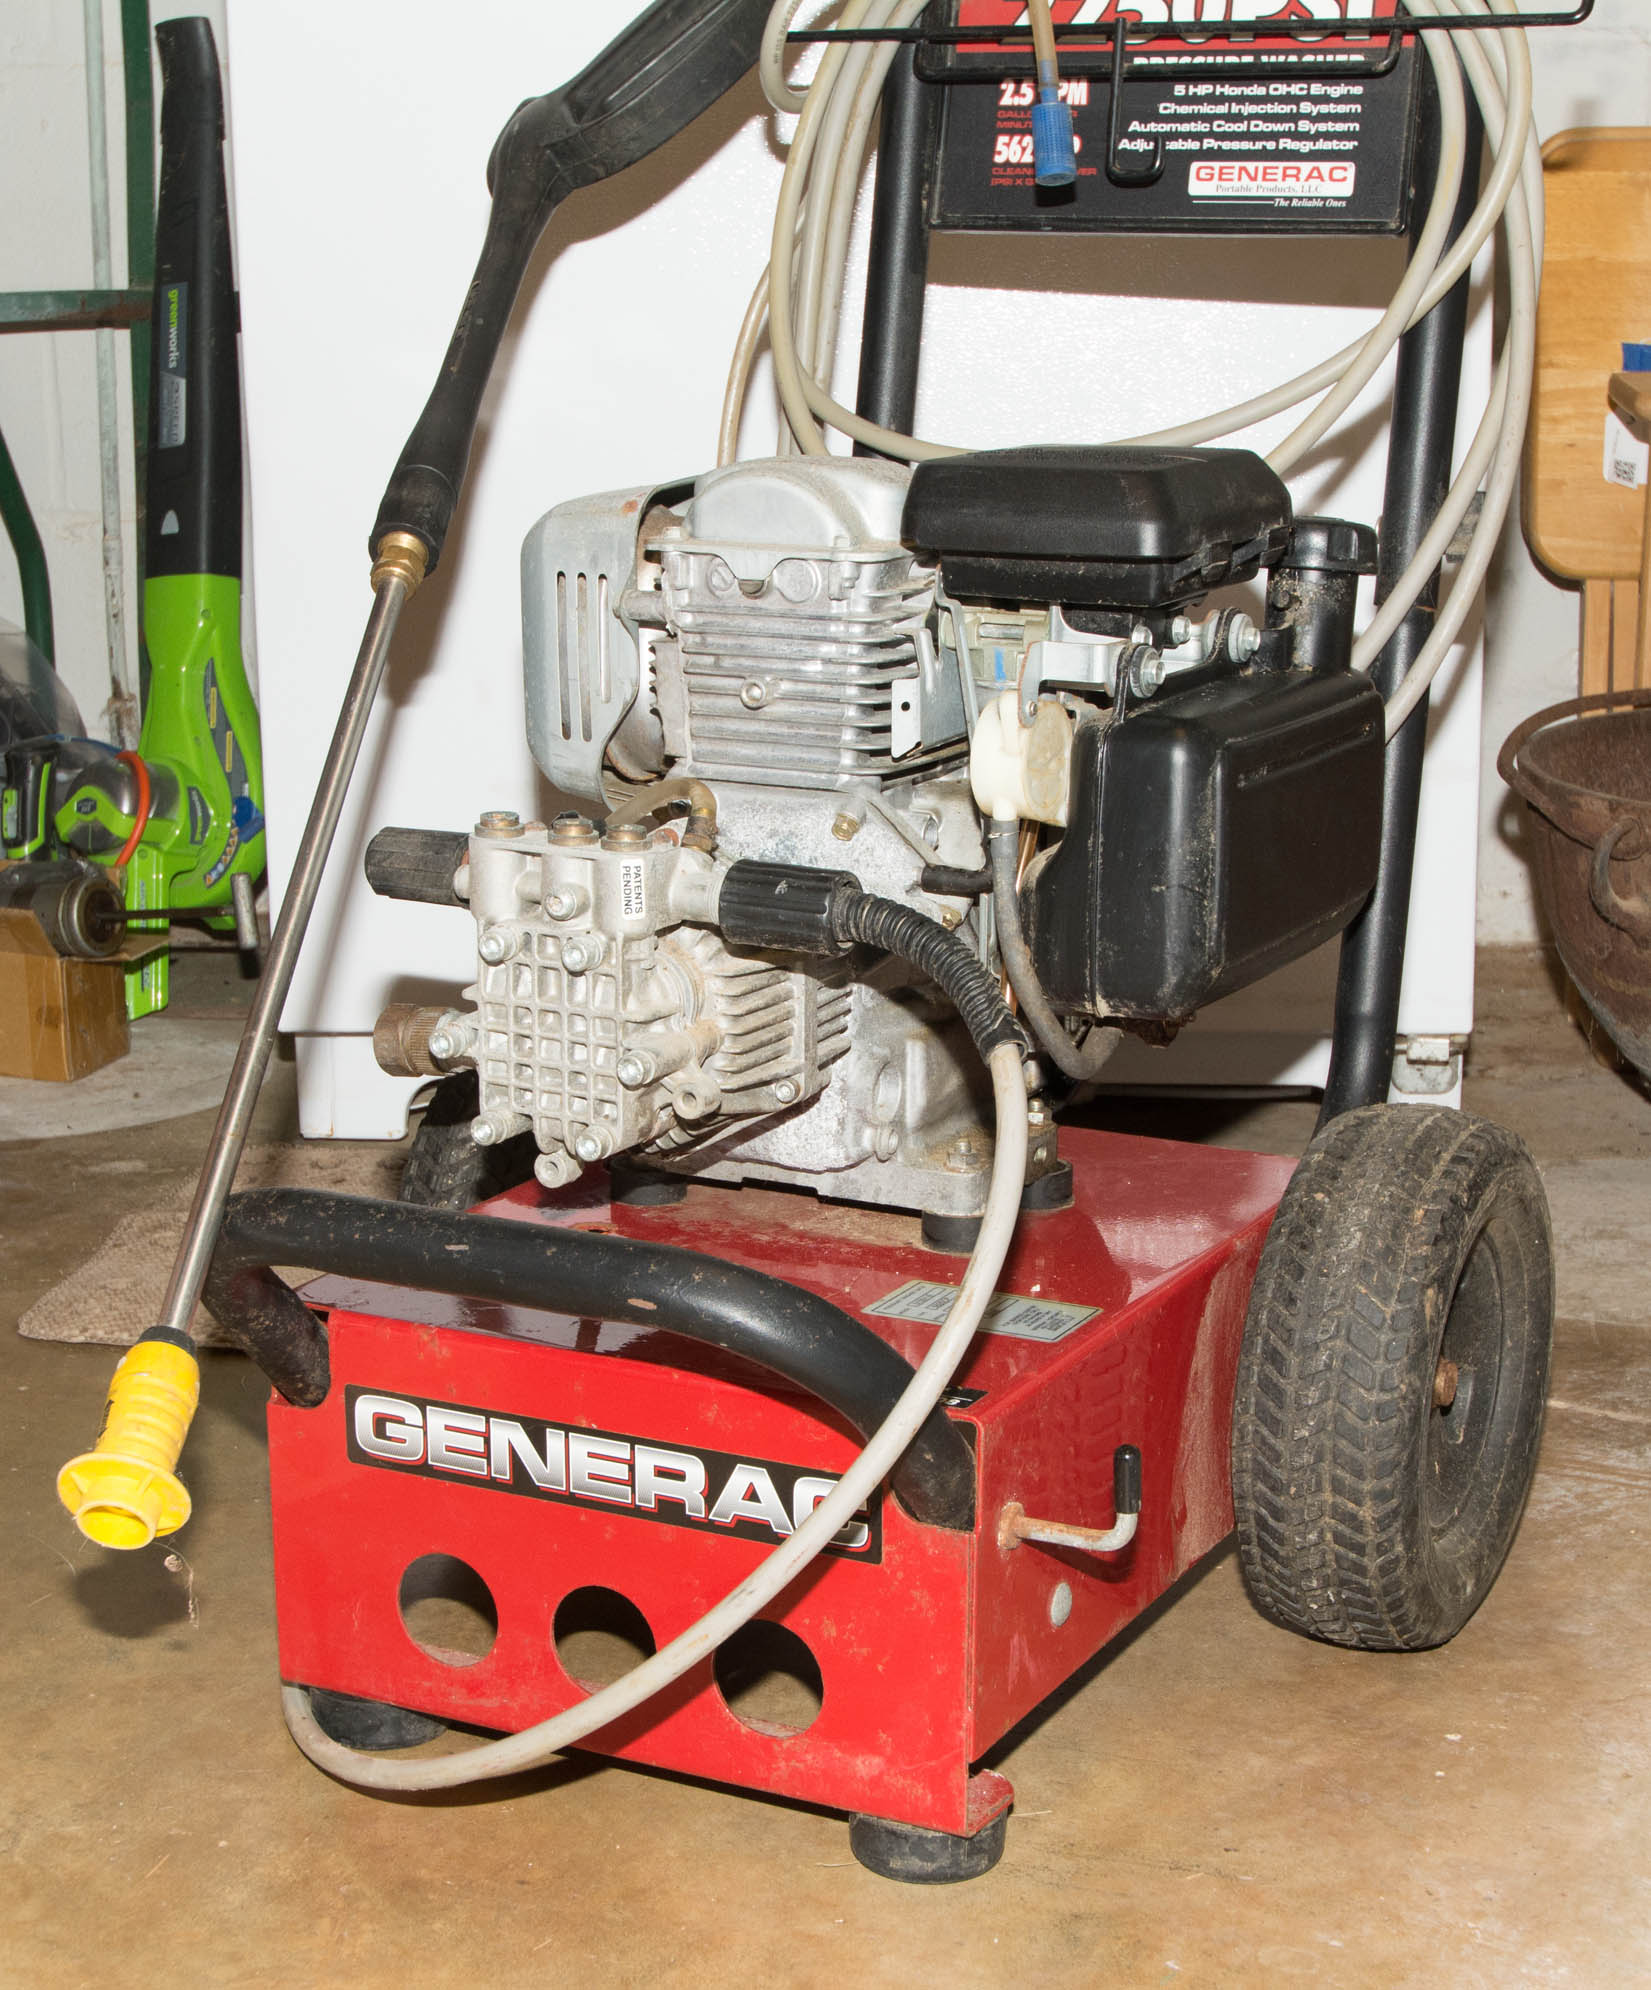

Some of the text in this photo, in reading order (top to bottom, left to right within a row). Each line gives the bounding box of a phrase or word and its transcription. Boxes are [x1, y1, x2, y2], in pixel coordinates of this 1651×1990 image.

[999, 79, 1089, 106] 2.5 PM
[1174, 84, 1185, 96] 5
[1188, 84, 1213, 96] HP
[1215, 84, 1266, 96] Honda
[1310, 83, 1363, 98] Engine
[1159, 102, 1362, 117] Chemical Injection System
[1128, 120, 1360, 134] Automatic Cool Down System
[1118, 138, 1358, 153] Adjuable Pressure Regulator
[1194, 165, 1349, 183] GENERAC
[1215, 183, 1323, 195] Portable Products, LLC
[1274, 198, 1347, 208] The Reliable Ones
[167, 288, 179, 370] greenworks
[622, 865, 633, 916] PENDING
[633, 865, 643, 915] PATENTS
